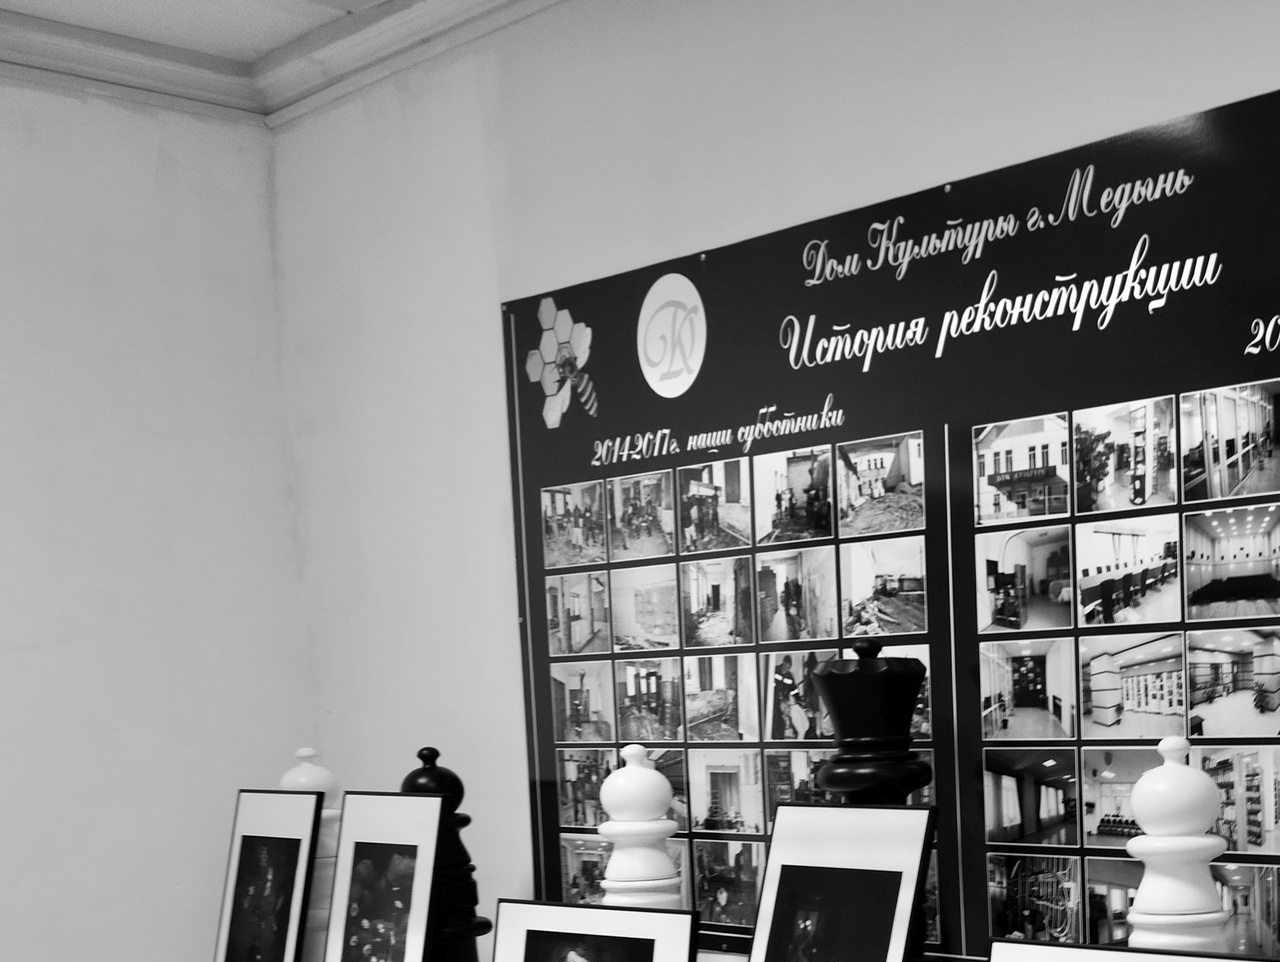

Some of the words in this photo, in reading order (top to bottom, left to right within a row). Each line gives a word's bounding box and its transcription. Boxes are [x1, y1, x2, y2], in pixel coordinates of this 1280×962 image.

[803, 239, 861, 287] Дом
[866, 215, 1019, 280] Культуры
[779, 314, 928, 372] История
[935, 234, 1222, 358] реконструкции
[686, 428, 733, 453] наши
[737, 392, 845, 453] субботники
